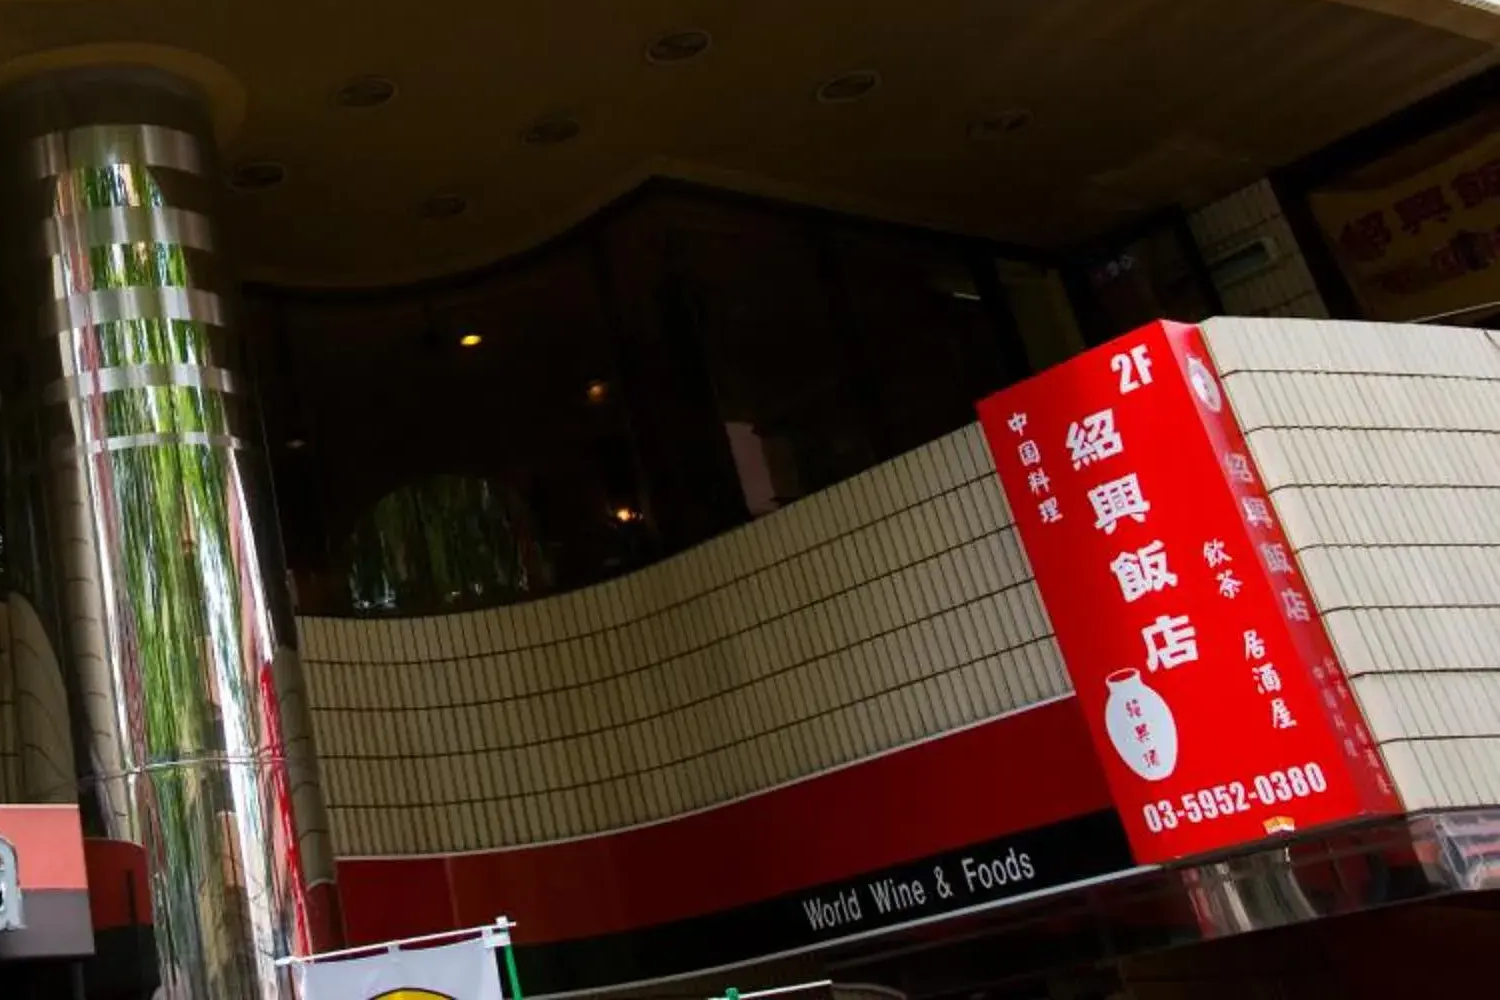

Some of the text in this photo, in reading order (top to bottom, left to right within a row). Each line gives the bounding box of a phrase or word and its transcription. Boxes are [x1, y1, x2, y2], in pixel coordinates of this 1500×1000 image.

[1110, 344, 1154, 395] 2F
[1007, 411, 1063, 524] 中国料理
[1064, 408, 1200, 674] 紹興飯店
[1202, 537, 1298, 731] 飲茶 居酒屋
[1143, 761, 1328, 834] 03-5952-0380
[802, 846, 1036, 931] World Wine & Foods
